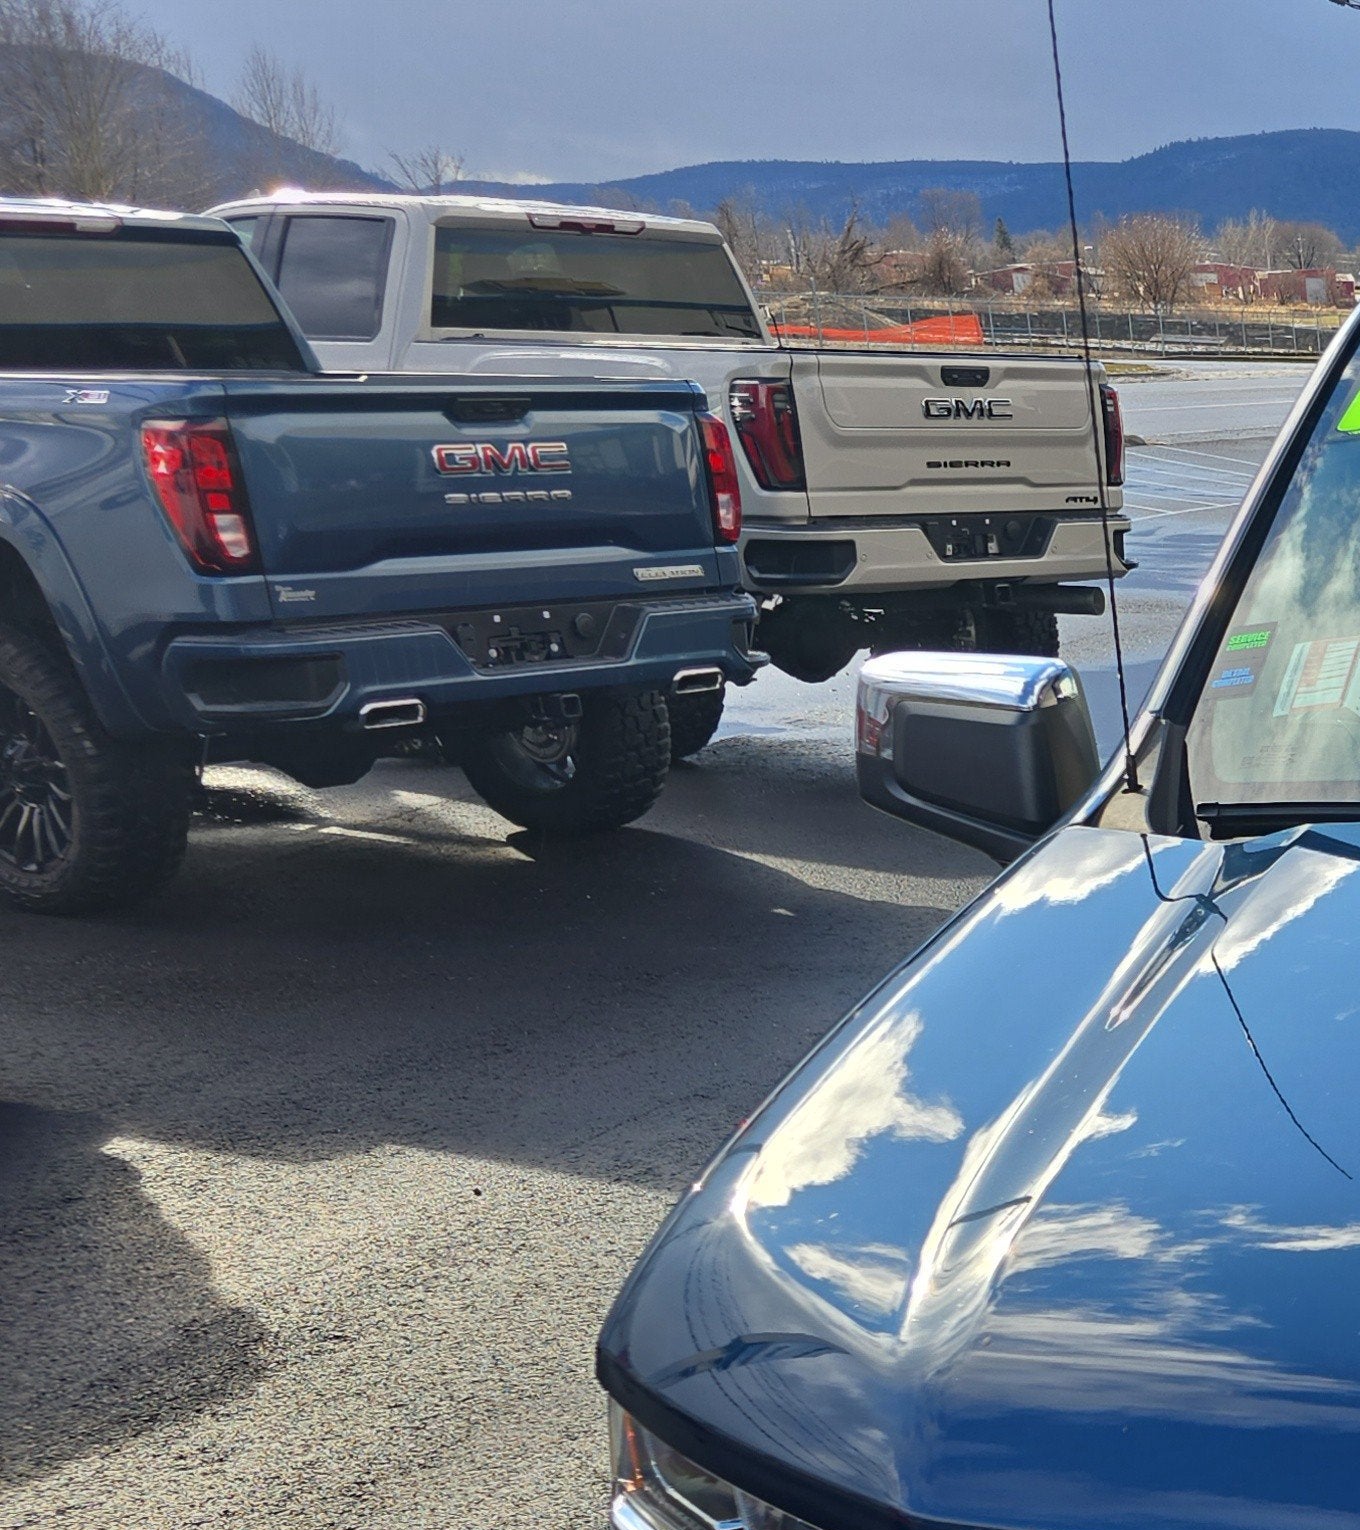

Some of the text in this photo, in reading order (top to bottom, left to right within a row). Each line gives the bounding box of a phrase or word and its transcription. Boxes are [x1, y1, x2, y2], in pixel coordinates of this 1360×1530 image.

[922, 397, 1013, 420] GMC
[431, 441, 572, 476] GMC
[926, 460, 1011, 469] SIERRA
[444, 489, 572, 505] SIERRA
[1065, 495, 1098, 505] AT4
